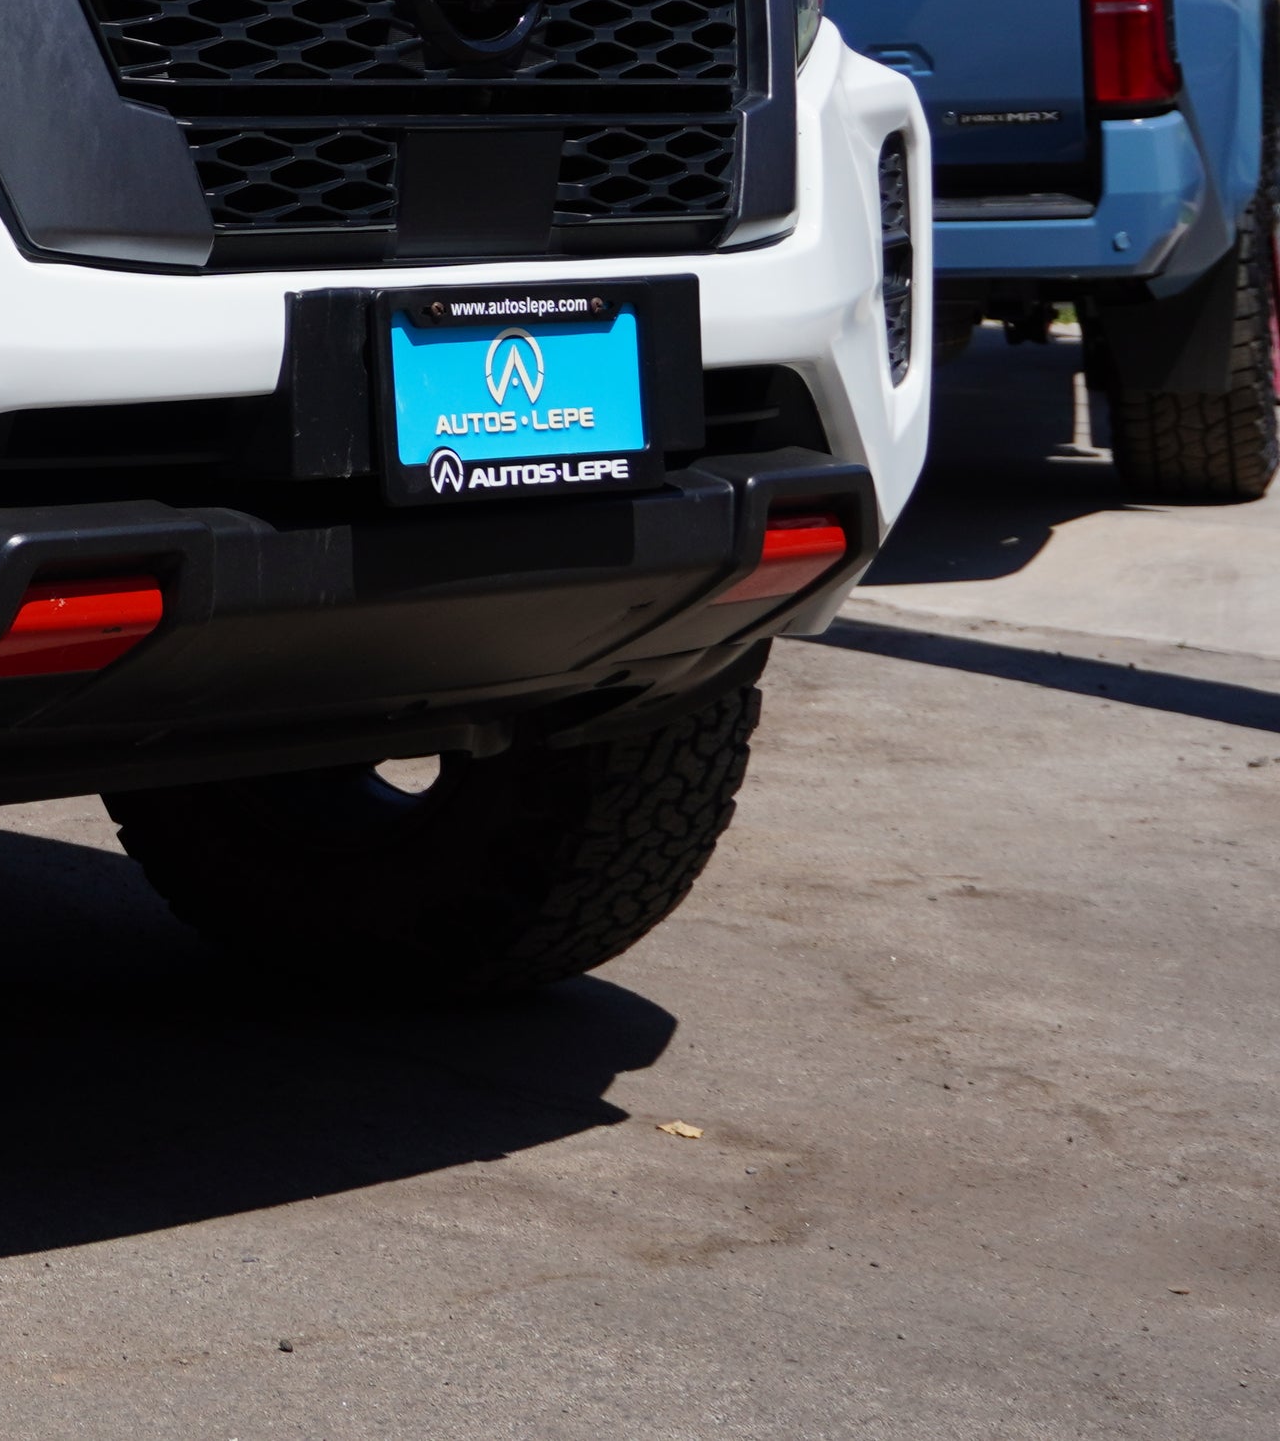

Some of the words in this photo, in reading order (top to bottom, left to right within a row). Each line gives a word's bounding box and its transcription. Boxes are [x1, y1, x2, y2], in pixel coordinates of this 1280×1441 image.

[450, 296, 588, 317] www.autoslepe.com
[435, 410, 517, 436] AUTOS
[531, 406, 595, 431] LEPE
